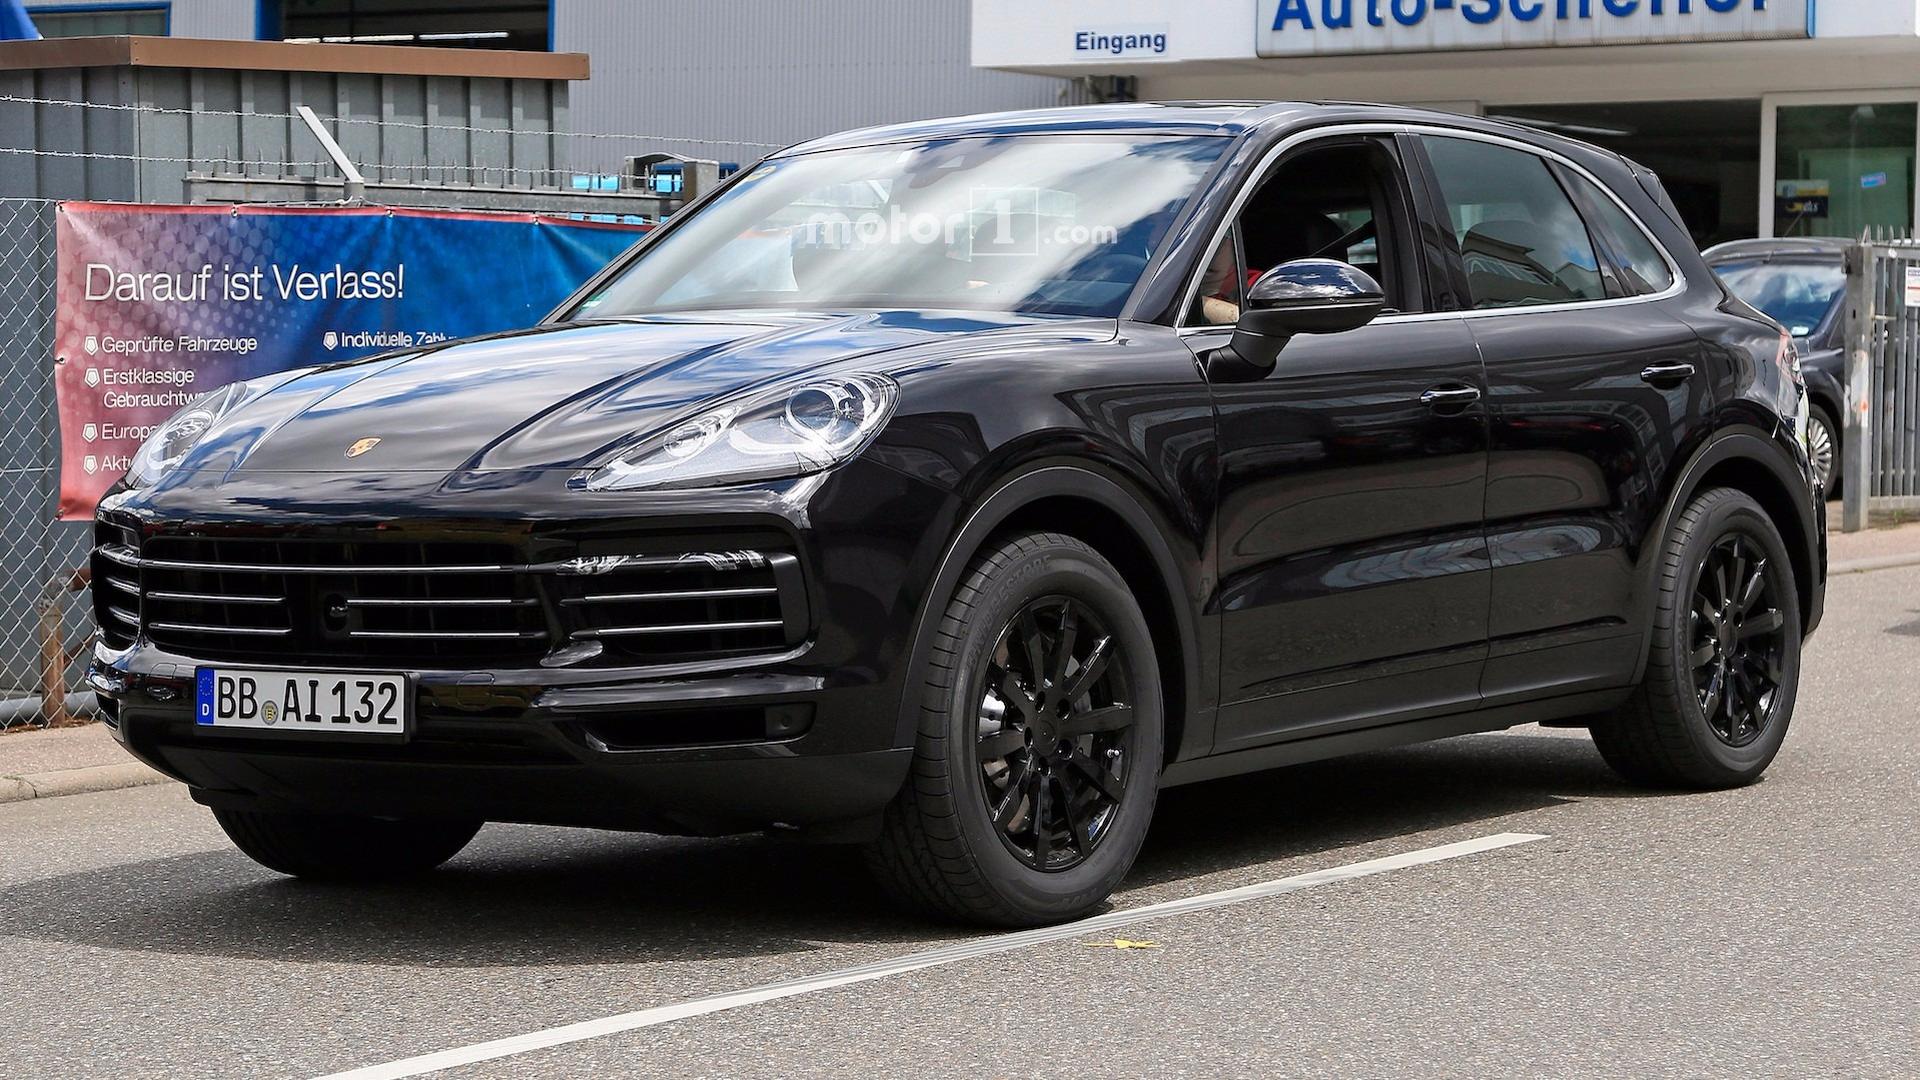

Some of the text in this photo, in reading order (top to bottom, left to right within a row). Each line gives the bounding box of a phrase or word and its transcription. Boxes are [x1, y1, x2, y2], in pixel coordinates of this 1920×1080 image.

[1076, 31, 1166, 54] Eingang
[85, 263, 404, 301] Darauf ist Verlass!
[101, 336, 258, 356] Geprüfte Fahrzeuge
[341, 331, 412, 348] Individuelle
[103, 368, 195, 387] Erstklassige
[202, 703, 210, 716] D
[217, 676, 398, 725] BB AI 132
